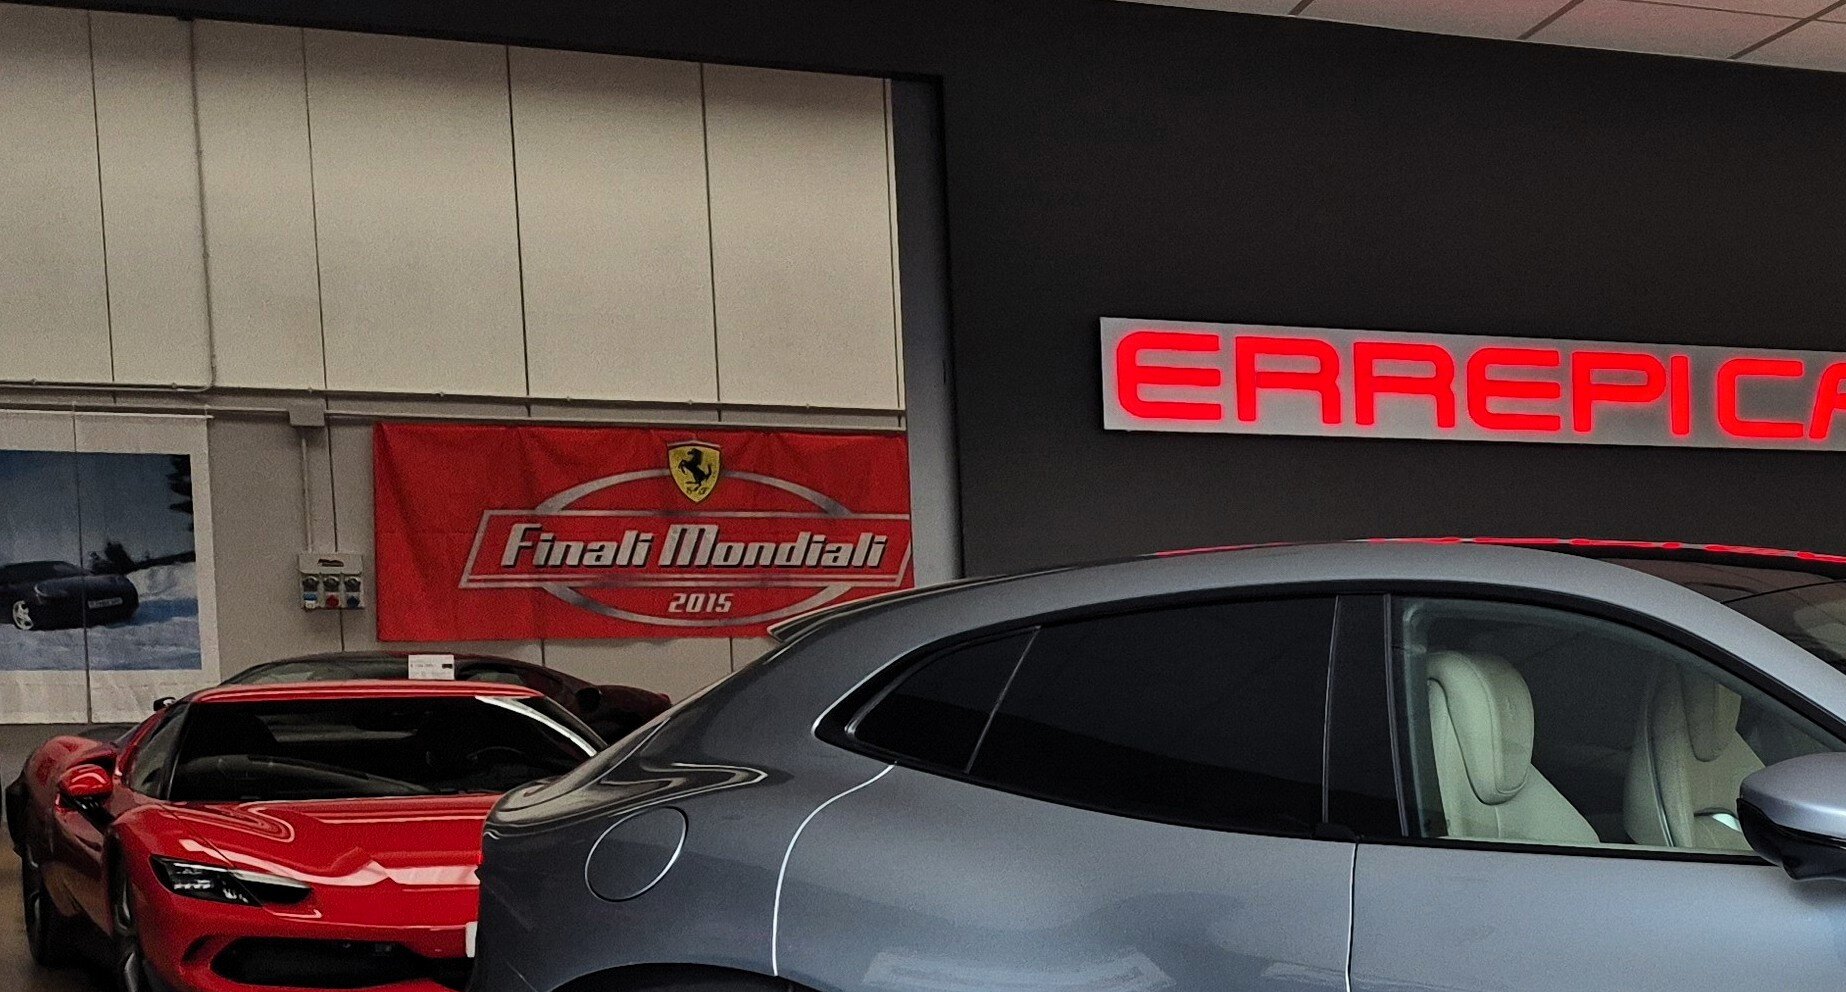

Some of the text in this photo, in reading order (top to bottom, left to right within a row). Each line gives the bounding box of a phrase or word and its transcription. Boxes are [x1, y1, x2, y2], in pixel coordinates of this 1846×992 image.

[500, 522, 889, 570] Finali Mondiali
[668, 592, 734, 613] 2015
